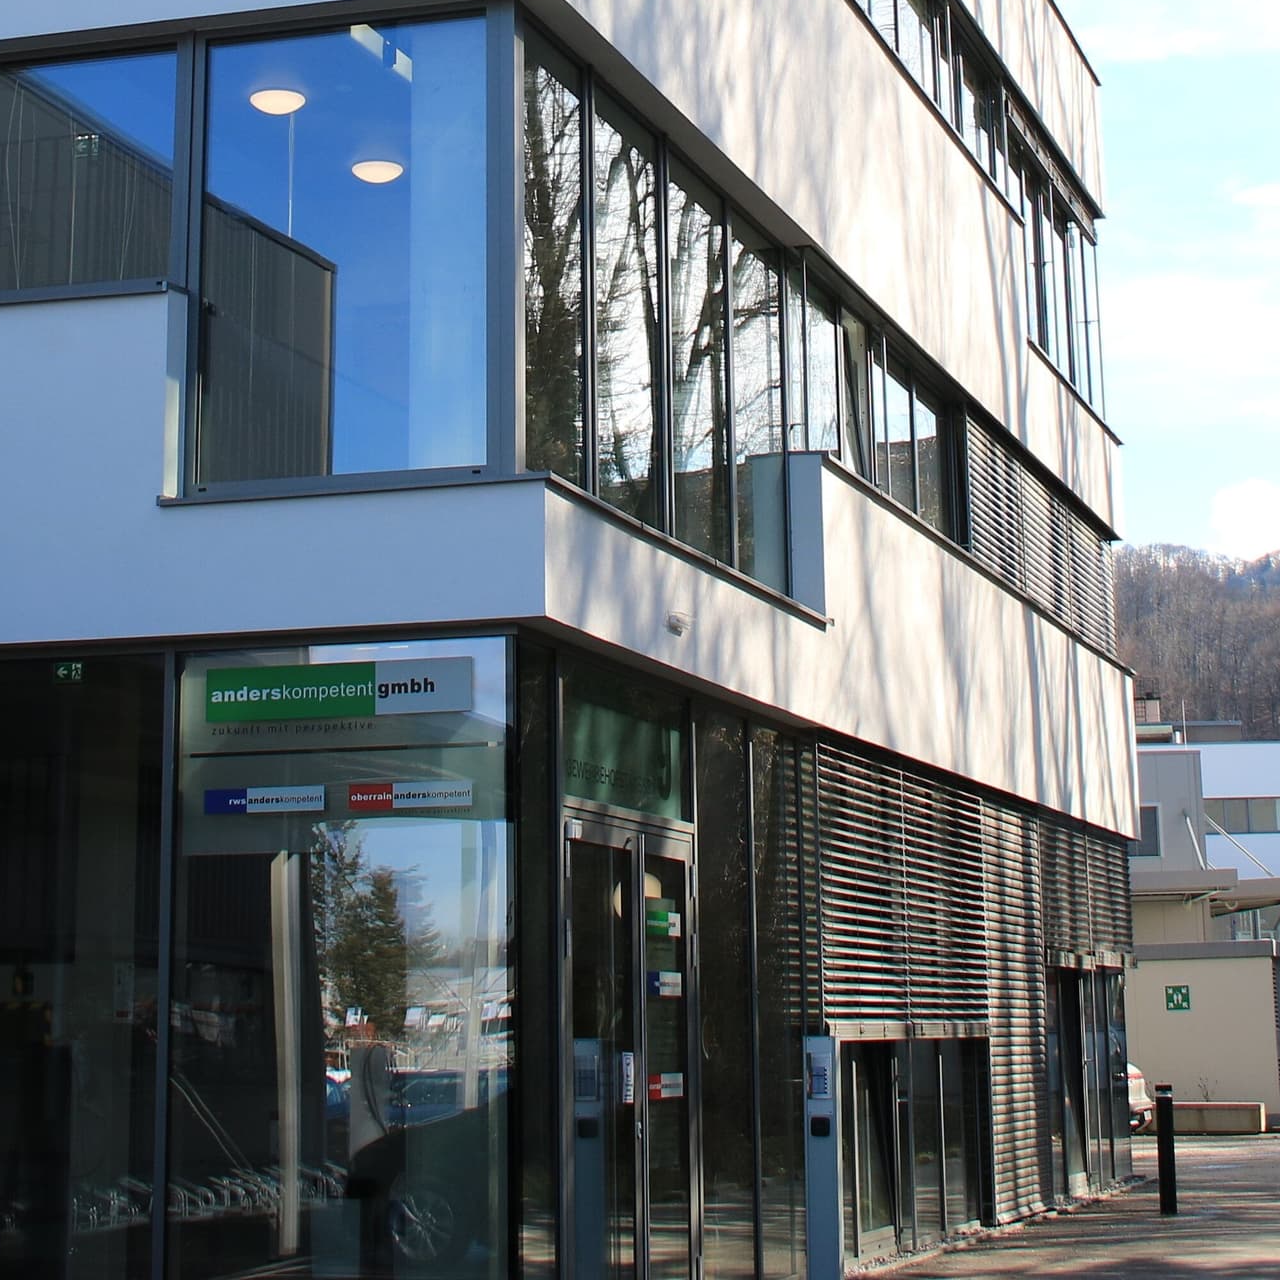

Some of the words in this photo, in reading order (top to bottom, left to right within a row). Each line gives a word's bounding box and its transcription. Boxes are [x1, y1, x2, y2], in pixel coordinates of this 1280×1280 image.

[211, 680, 373, 703] anderskompetent
[377, 677, 435, 699] gmbh
[212, 724, 261, 736] zukunft
[268, 723, 289, 733] mit
[229, 798, 246, 806] rws
[248, 795, 323, 804] anderskompetent
[351, 791, 392, 802] oberrain
[393, 790, 471, 800] anderskompetent
